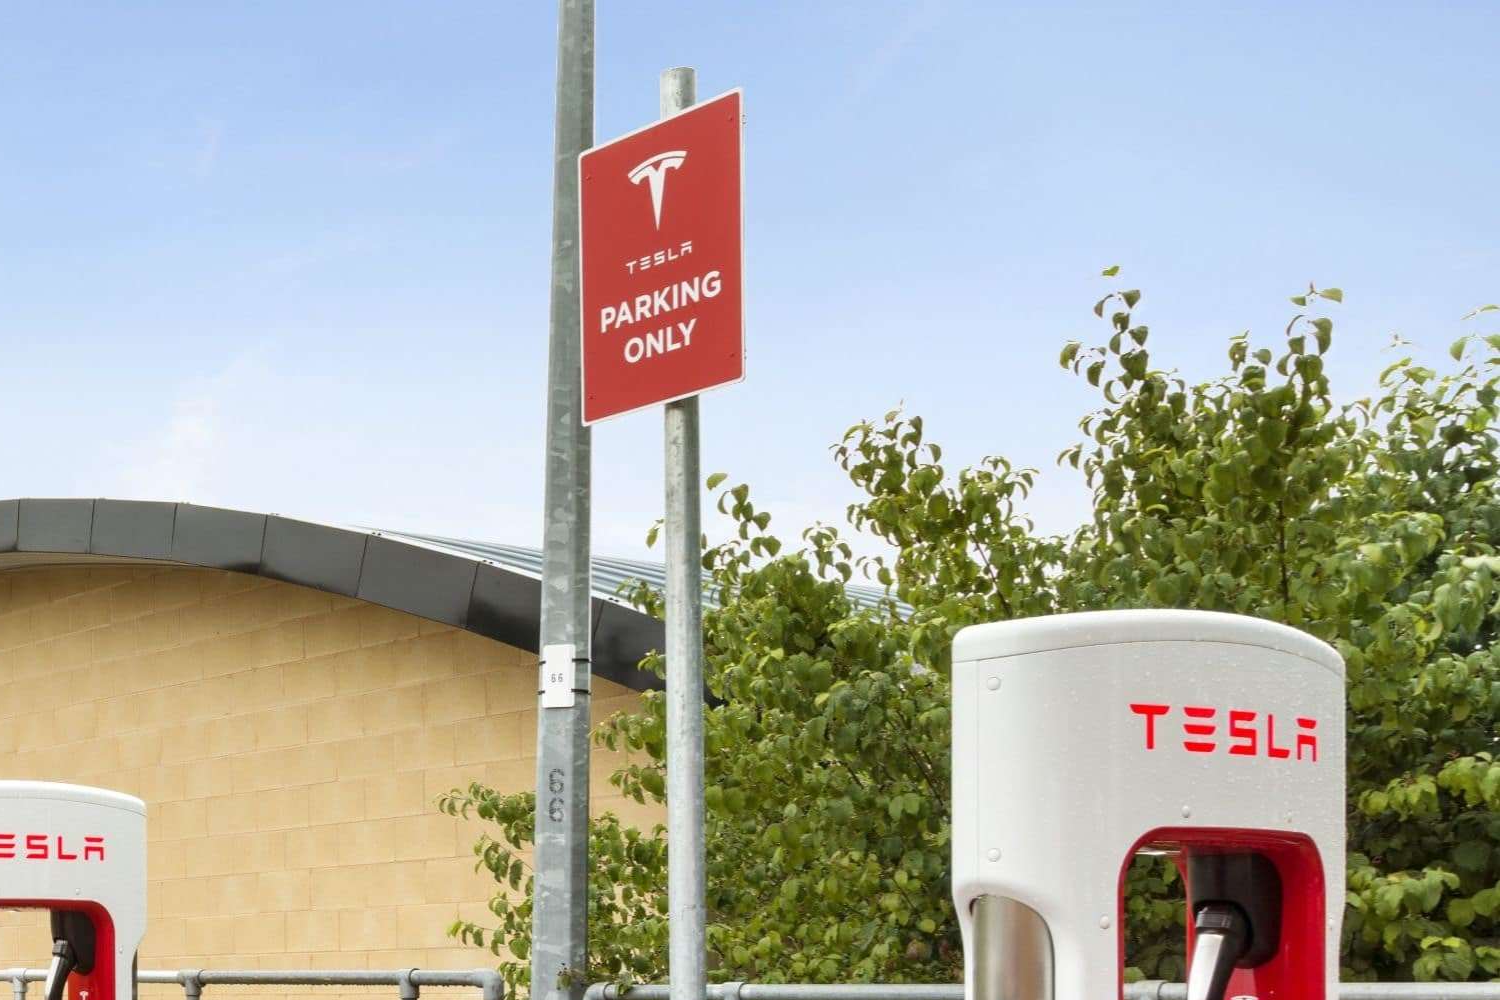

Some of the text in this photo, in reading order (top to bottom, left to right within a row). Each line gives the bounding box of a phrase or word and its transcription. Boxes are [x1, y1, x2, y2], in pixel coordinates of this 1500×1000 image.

[625, 240, 693, 275] TESLA
[600, 270, 722, 333] PARKING
[623, 318, 697, 364] ONLY
[1129, 703, 1319, 763] TESLA
